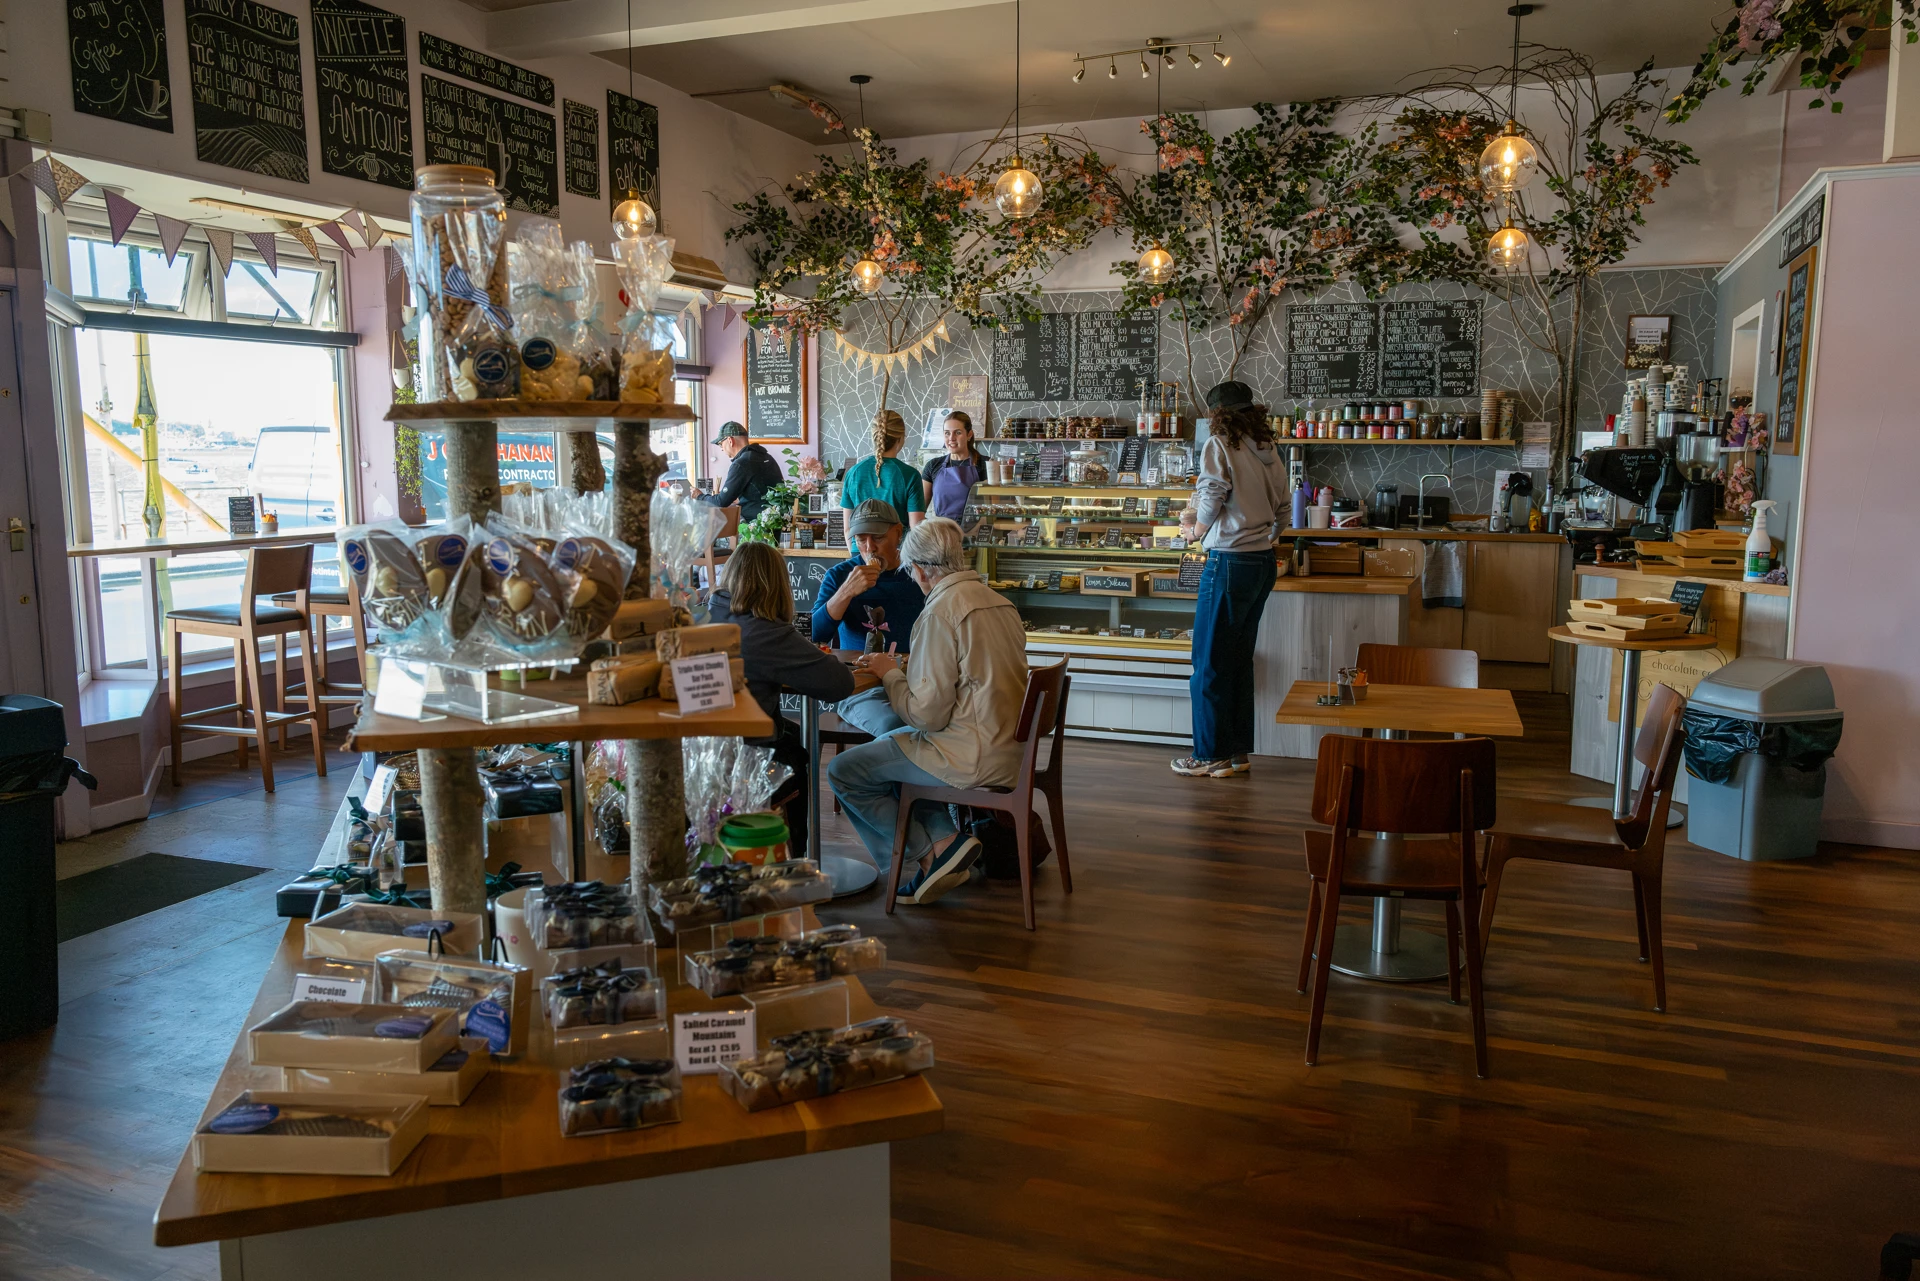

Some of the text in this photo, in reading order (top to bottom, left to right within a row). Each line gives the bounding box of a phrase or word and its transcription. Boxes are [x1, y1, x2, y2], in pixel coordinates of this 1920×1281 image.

[73, 1, 110, 28] as my
[242, 2, 298, 37] A BREW?
[315, 15, 401, 55] WAFFLE
[73, 36, 122, 73] Coffee
[191, 24, 300, 72] OUR TEA COMES FROM
[423, 34, 536, 84] WE USE SHORTBREAD AND TABLET
[191, 43, 302, 94] TLC WHO SOURCE RARE
[369, 63, 407, 82] A WEEK
[426, 50, 537, 99] MADE BY SMALL SCOTTISH SUPPLIERS
[216, 71, 256, 99] ELEVATION
[259, 83, 279, 106] TEAS
[282, 91, 304, 113] FROM
[321, 67, 409, 111] STOPS YOU FEELING
[424, 78, 440, 98] OUR
[441, 82, 465, 105] COFFEE
[226, 95, 252, 115] FAMILY
[256, 102, 303, 129] PLANTATIONS
[504, 103, 520, 121] 100%
[329, 94, 412, 157] ANTIQUE
[457, 107, 484, 135] Roasted
[511, 123, 549, 144] CHOCOLATEY
[427, 130, 486, 155] EVERY WEEK BY SMALL
[614, 137, 647, 162] FRESHLY
[643, 139, 655, 150] ARE
[434, 145, 458, 162] SCOTTISH
[534, 145, 555, 164] SWEET
[584, 146, 592, 158] IS
[572, 156, 597, 174] HOMEMADE
[528, 192, 550, 213] Coffee
[1334, 304, 1368, 312] MILKSHAKES
[1393, 302, 1407, 310] TEA
[1418, 302, 1434, 310] CHAI
[1430, 325, 1442, 333] LATTE
[1011, 338, 1027, 346] LATTE
[1348, 336, 1368, 344] CREAM
[1387, 334, 1408, 342] WHITE
[1424, 334, 1446, 342] MATCHA
[873, 336, 934, 366] CREAM
[1011, 353, 1028, 361] WHITE
[995, 361, 1022, 369] ESPRESSO
[1307, 368, 1328, 376] COFFEE
[952, 379, 972, 393] Coffee
[1308, 376, 1326, 384] LATTE
[755, 385, 792, 396] HOT BROWNIE
[1018, 390, 1035, 398] MOCHA
[1290, 385, 1326, 394] ICED MOCHA
[427, 441, 555, 462] J HANAN
[498, 469, 555, 481] CONTRACTO
[1085, 576, 1129, 588] Lemon Sultana
[1154, 580, 1171, 590] PLAIN
[792, 589, 810, 600] EAM
[308, 984, 347, 997] Chocolate
[683, 1017, 746, 1030] Salted Caramel
[692, 1030, 736, 1041] Mountains
[689, 1056, 701, 1064] Box
